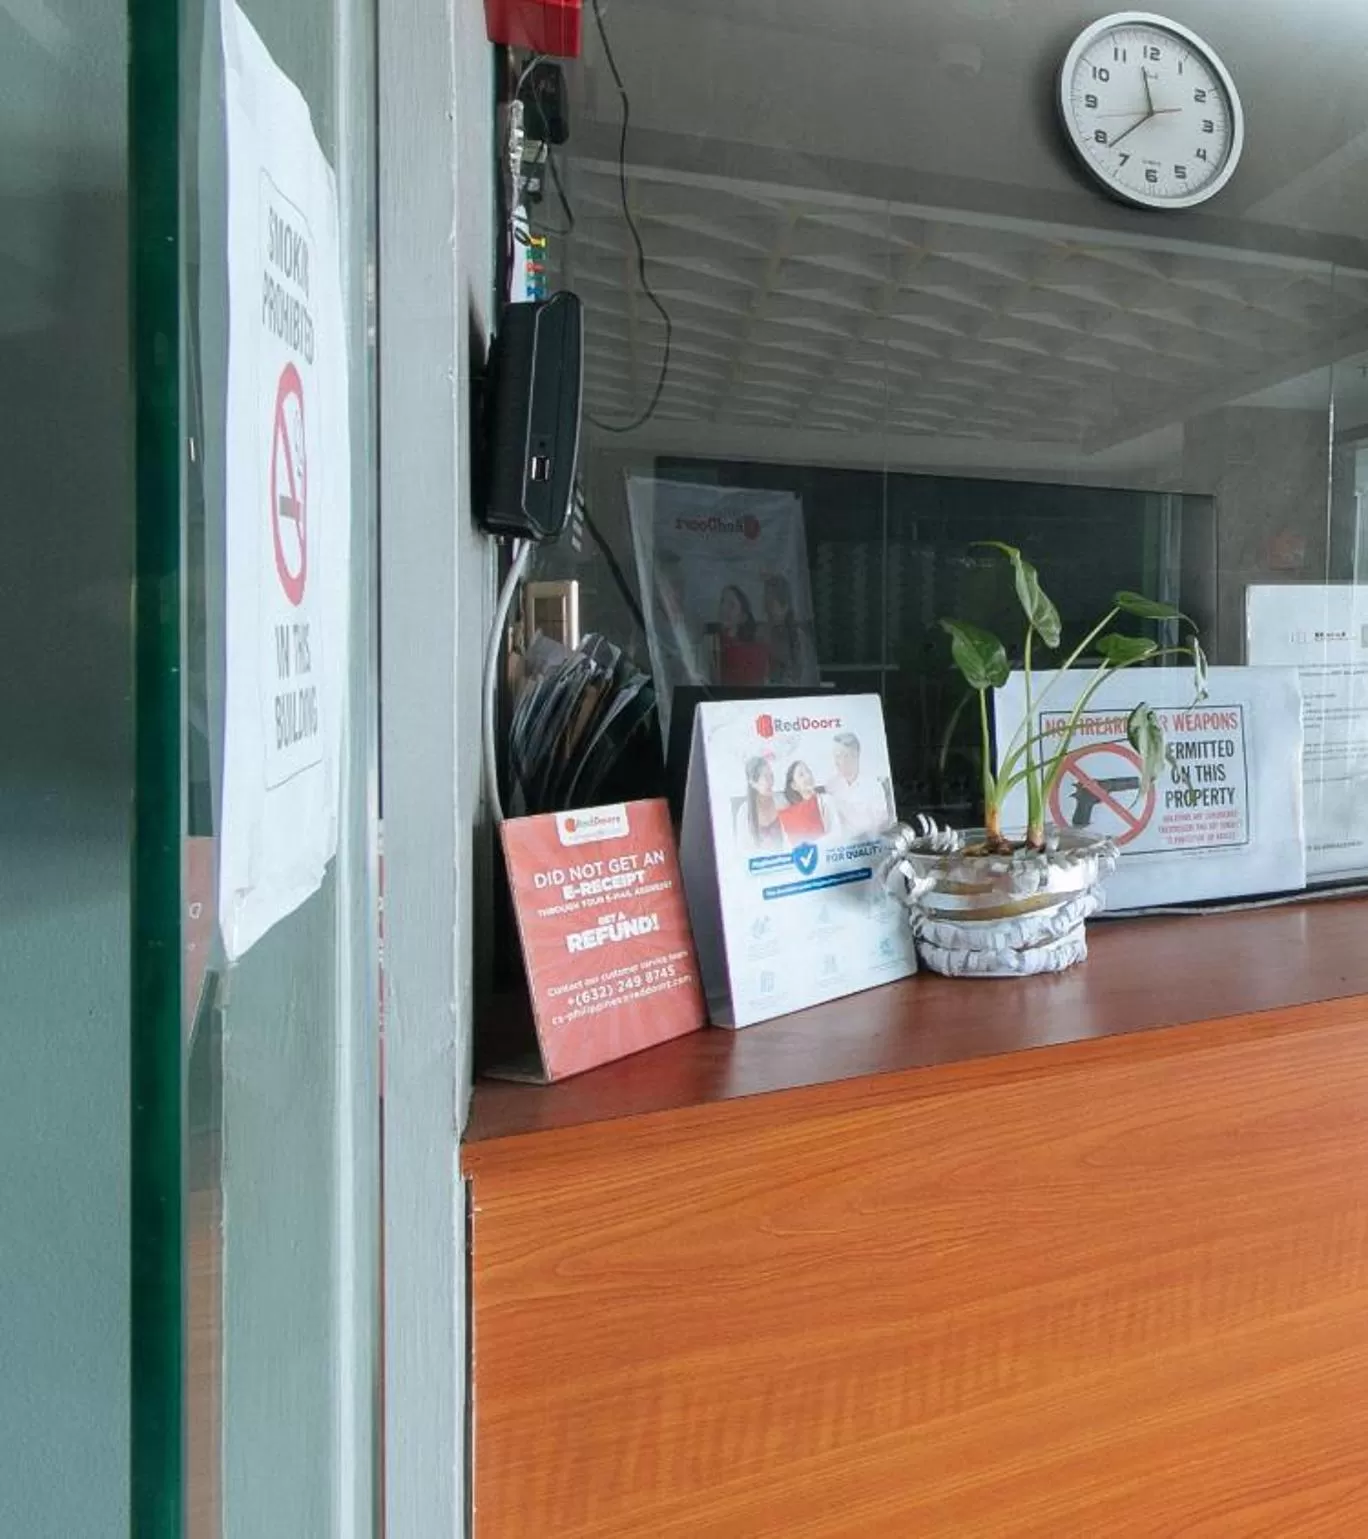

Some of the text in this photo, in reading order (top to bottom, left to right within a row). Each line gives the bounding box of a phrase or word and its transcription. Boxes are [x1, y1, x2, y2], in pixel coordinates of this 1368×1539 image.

[1113, 47, 1126, 63] 11
[1143, 45, 1160, 61] 12
[1092, 66, 1110, 82] 10
[1178, 60, 1183, 76] 1
[1085, 94, 1098, 109] 9
[1194, 88, 1207, 104] 2
[1202, 119, 1214, 134] 3
[1094, 129, 1107, 145] 8
[1118, 153, 1130, 167] 7
[1196, 148, 1207, 163] 4
[1145, 169, 1158, 184] 6
[1174, 165, 1187, 180] 5
[275, 624, 290, 680] IN
[275, 686, 317, 751] BUILDING
[1172, 712, 1237, 732] WEAPONS
[1165, 740, 1235, 760] ERMITTED
[1171, 763, 1226, 784] ON THIS
[1165, 787, 1235, 809] PROPERTY
[534, 849, 666, 889] DID NOT GET AN
[562, 870, 645, 900] E-RECEIPT
[566, 912, 660, 953] REFUND!
[618, 975, 641, 993] 249
[645, 964, 676, 984] 8745
